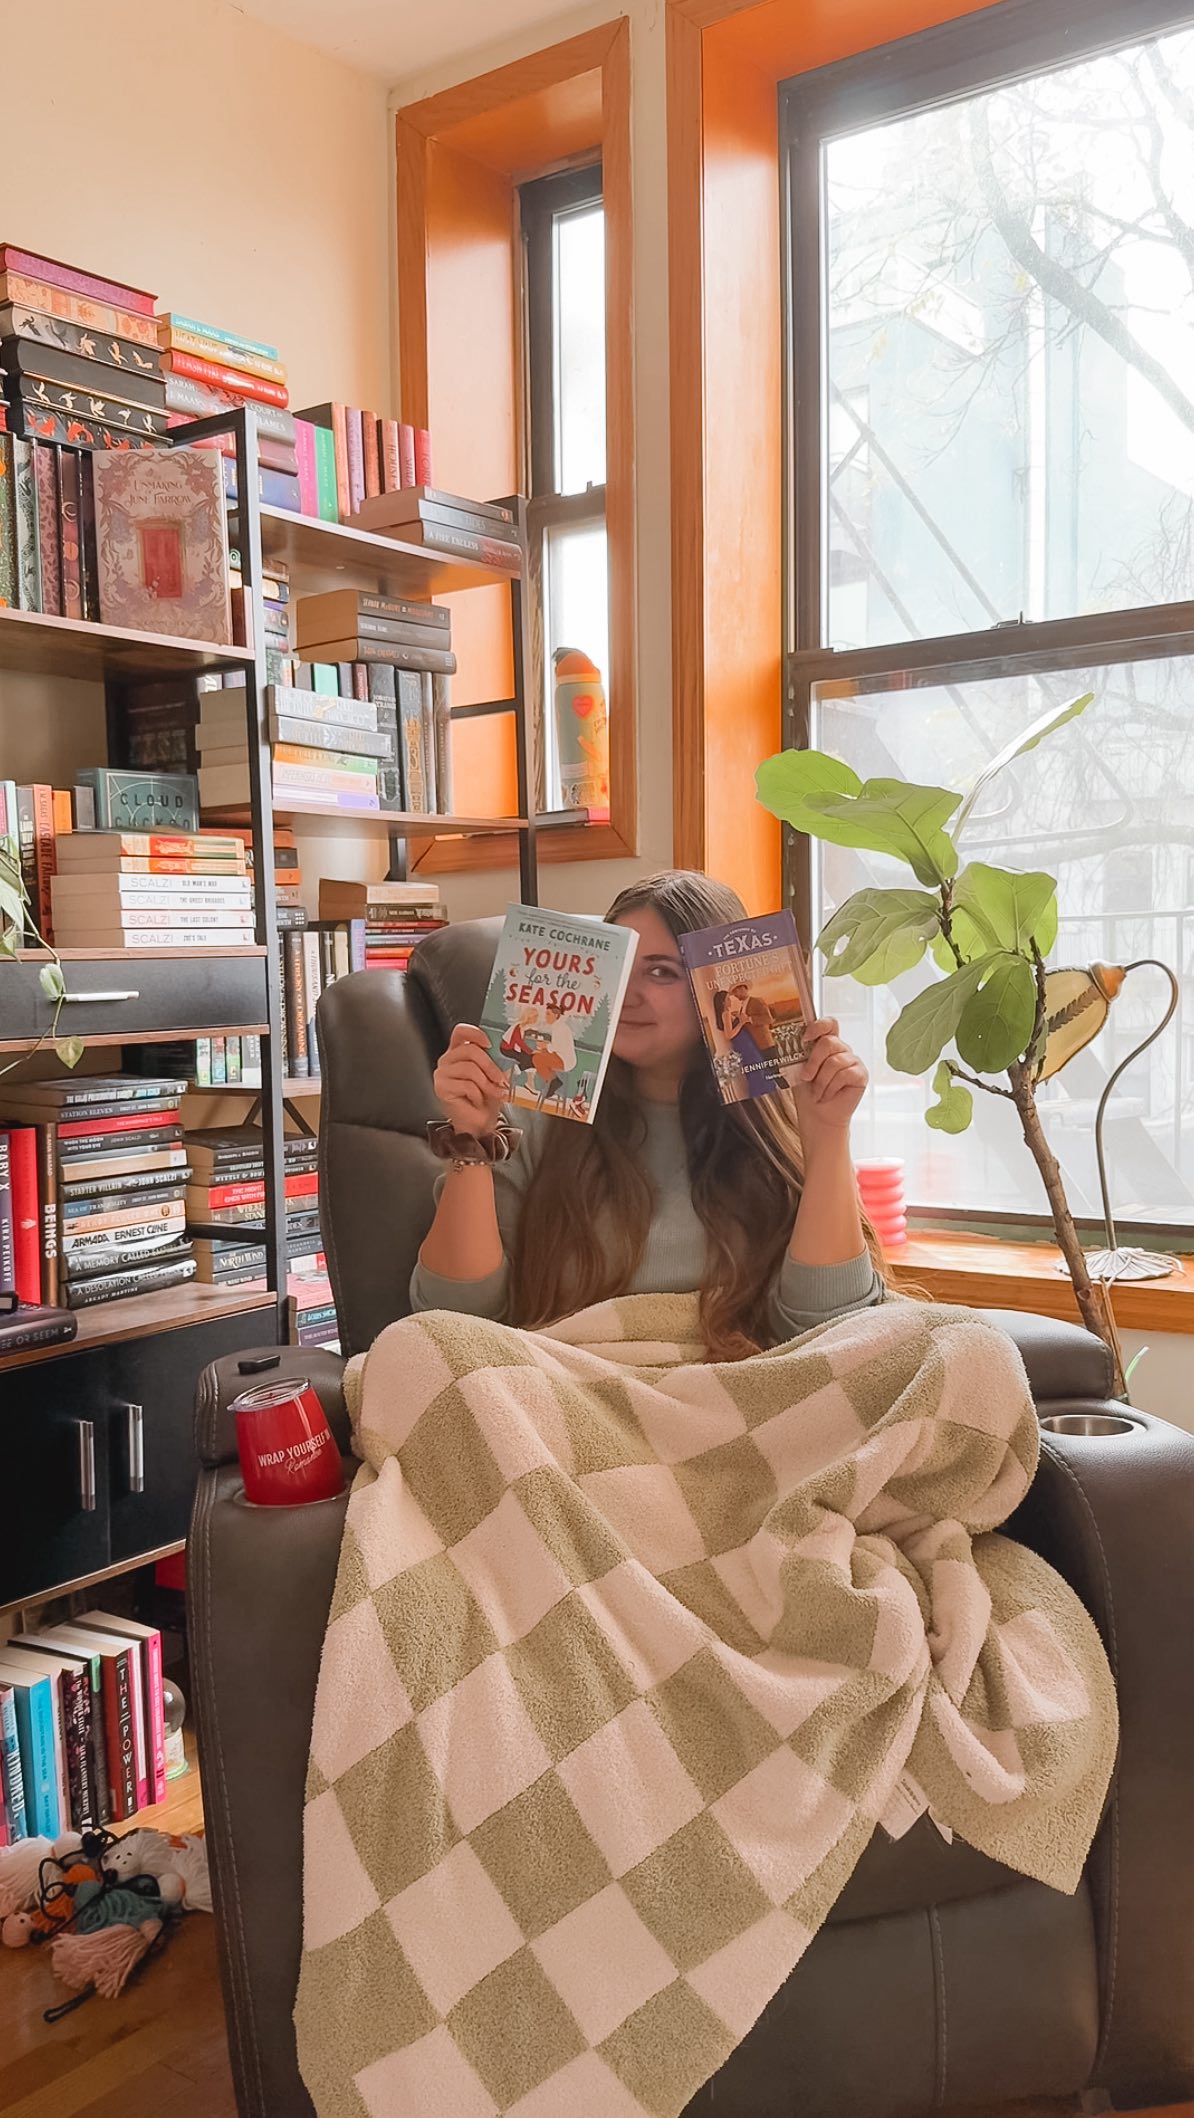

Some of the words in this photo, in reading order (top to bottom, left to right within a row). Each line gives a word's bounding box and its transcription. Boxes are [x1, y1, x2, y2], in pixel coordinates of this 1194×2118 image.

[167, 376, 198, 392] SARAH
[153, 491, 192, 506] FARROW
[120, 793, 183, 808] CLOUD
[130, 877, 172, 888] SCALZI
[128, 895, 169, 905] SCALZI
[129, 915, 170, 926] SCALZI
[131, 934, 174, 944] SCALZI
[518, 921, 546, 937] KATE
[549, 928, 611, 951] COCHRANE
[713, 932, 773, 958] TEXAS
[523, 946, 596, 976] YOURS
[715, 953, 780, 977] FORTUNE'S
[294, 959, 303, 992] THEORY
[524, 967, 552, 986] for
[556, 972, 582, 990] the
[705, 966, 770, 991] UNEXPECTED
[505, 983, 594, 1015] SEASON
[296, 1005, 304, 1057] DREAMING
[741, 1058, 780, 1074] JENNIFER
[61, 1109, 88, 1118] STATION
[88, 1107, 113, 1116] ELEVEN
[0, 1144, 10, 1177] BABY
[0, 1182, 10, 1191] X
[70, 1184, 97, 1197] STARTER
[98, 1181, 122, 1193] VILLAIN
[138, 1176, 154, 1187] JOHN
[154, 1172, 177, 1184] SCALZI
[1, 1218, 10, 1243] KIRA
[44, 1203, 57, 1259] BEINGS
[71, 1233, 110, 1249] ARMADA
[114, 1227, 145, 1241] ERNEST
[146, 1222, 169, 1234] CLINE
[2, 1245, 12, 1283] PEIKOFF
[76, 1263, 82, 1271] A
[84, 1256, 119, 1270] MEMORY
[121, 1250, 150, 1263] CALLED
[245, 1251, 264, 1262] WIND
[77, 1287, 84, 1295] A
[86, 1277, 131, 1294] DESOLATION
[0, 1338, 13, 1349] EE
[16, 1334, 30, 1345] OR
[32, 1328, 59, 1342] SEEM
[258, 1450, 285, 1468] WRAP
[286, 1431, 326, 1459] YOURSELF
[118, 1667, 128, 1709] THE
[121, 1724, 133, 1794] POWER
